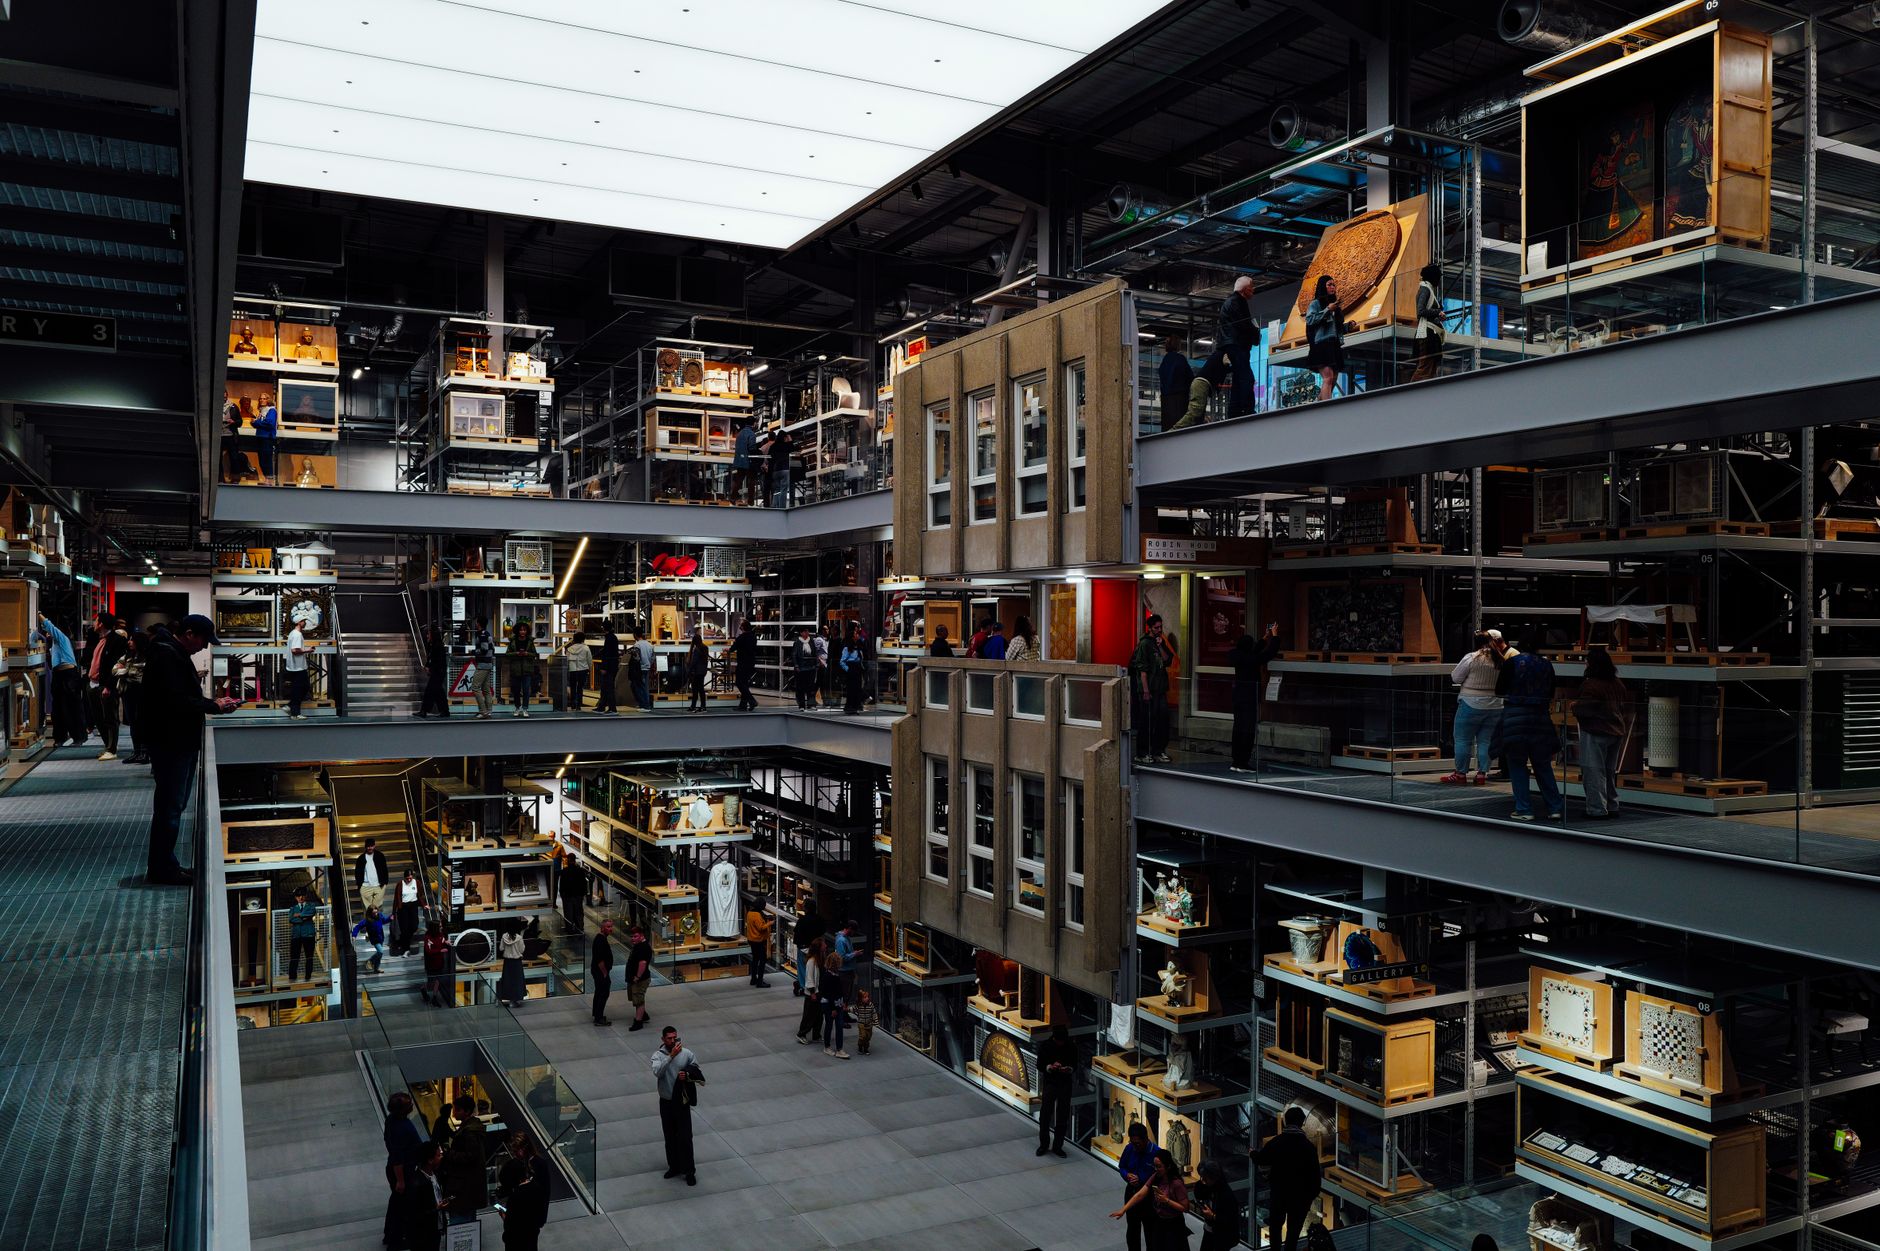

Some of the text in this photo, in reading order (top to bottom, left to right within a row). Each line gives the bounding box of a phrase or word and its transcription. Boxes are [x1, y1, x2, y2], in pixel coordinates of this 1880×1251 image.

[1706, 0, 1719, 11] 05
[1384, 134, 1392, 143] 04
[92, 324, 107, 341] 3
[1148, 540, 1181, 548] ROBIN
[1148, 551, 1195, 559] GARDENS
[1701, 555, 1713, 563] 05
[1351, 967, 1404, 982] GALLERY
[1698, 1002, 1710, 1013] 08
